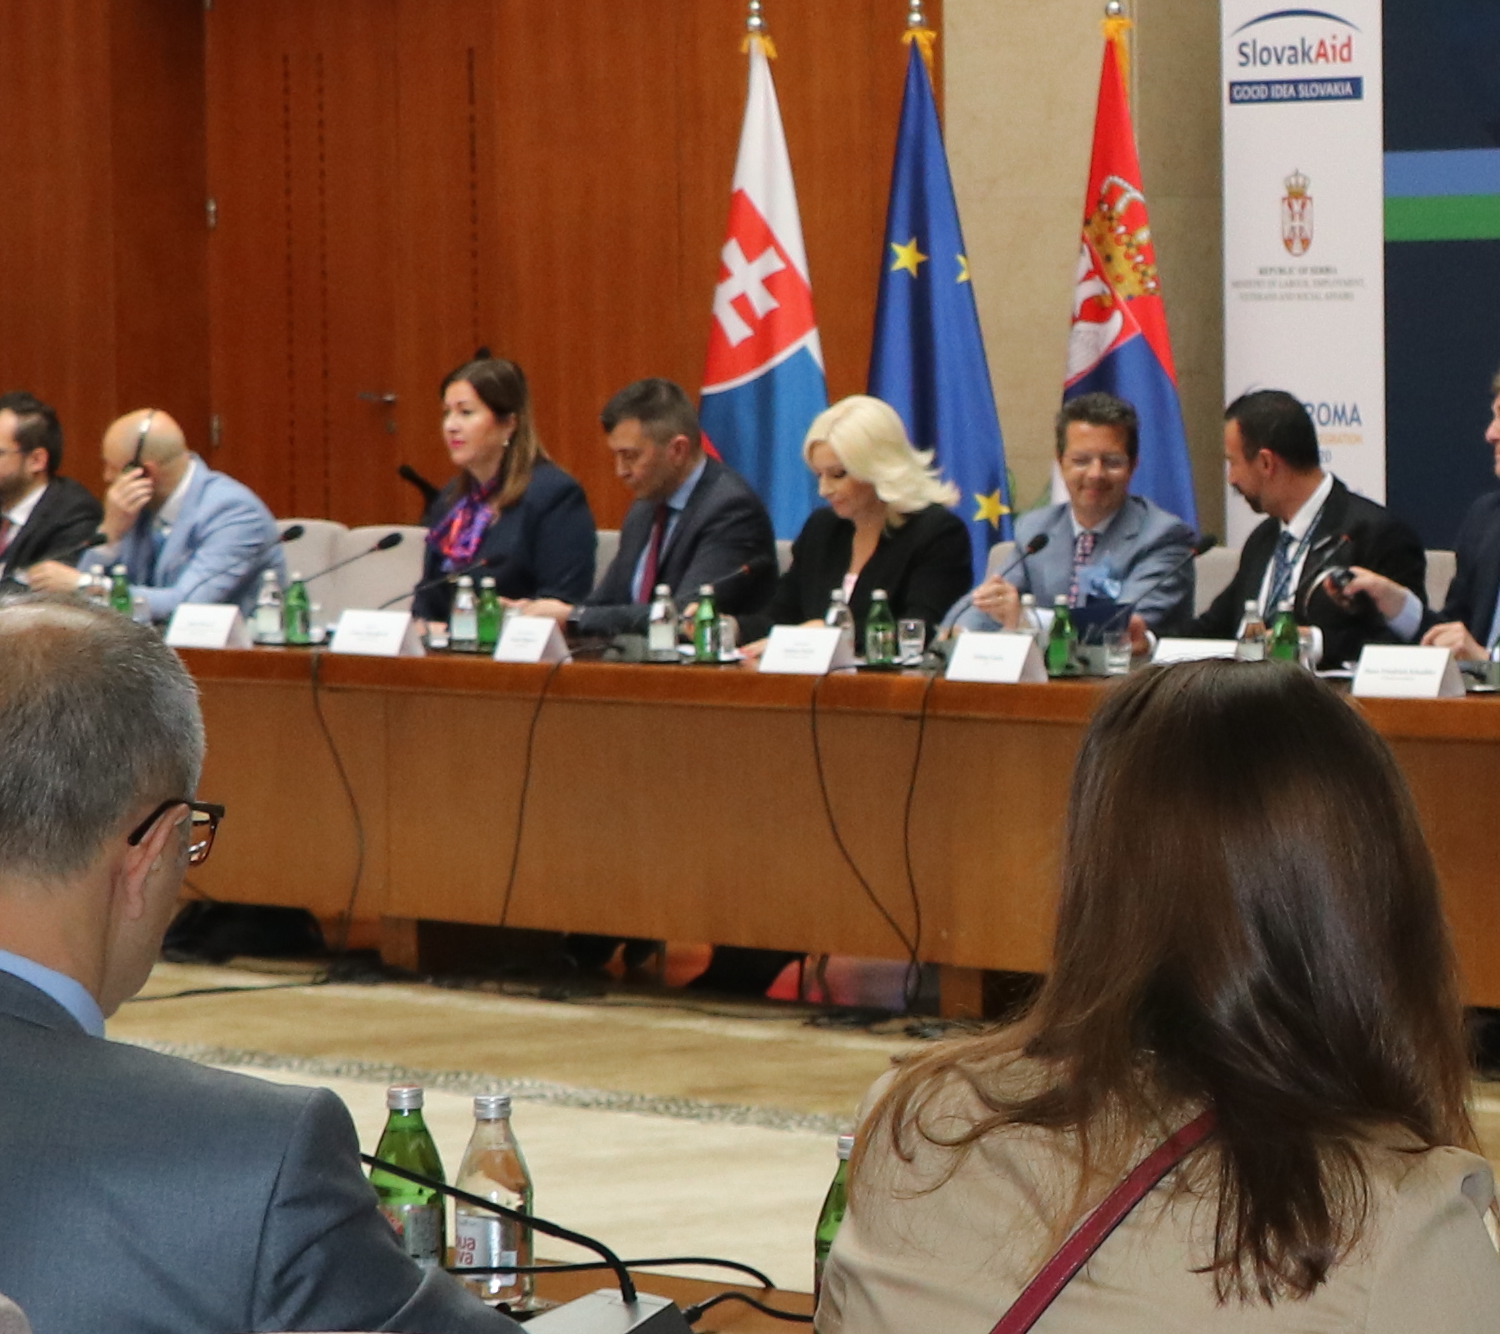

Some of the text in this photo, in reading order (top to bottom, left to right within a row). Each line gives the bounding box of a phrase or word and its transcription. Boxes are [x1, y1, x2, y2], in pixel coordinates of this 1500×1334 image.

[1238, 34, 1352, 67] SlovakAid
[1233, 80, 1353, 100] GOOD IDEA SLOVAKIA
